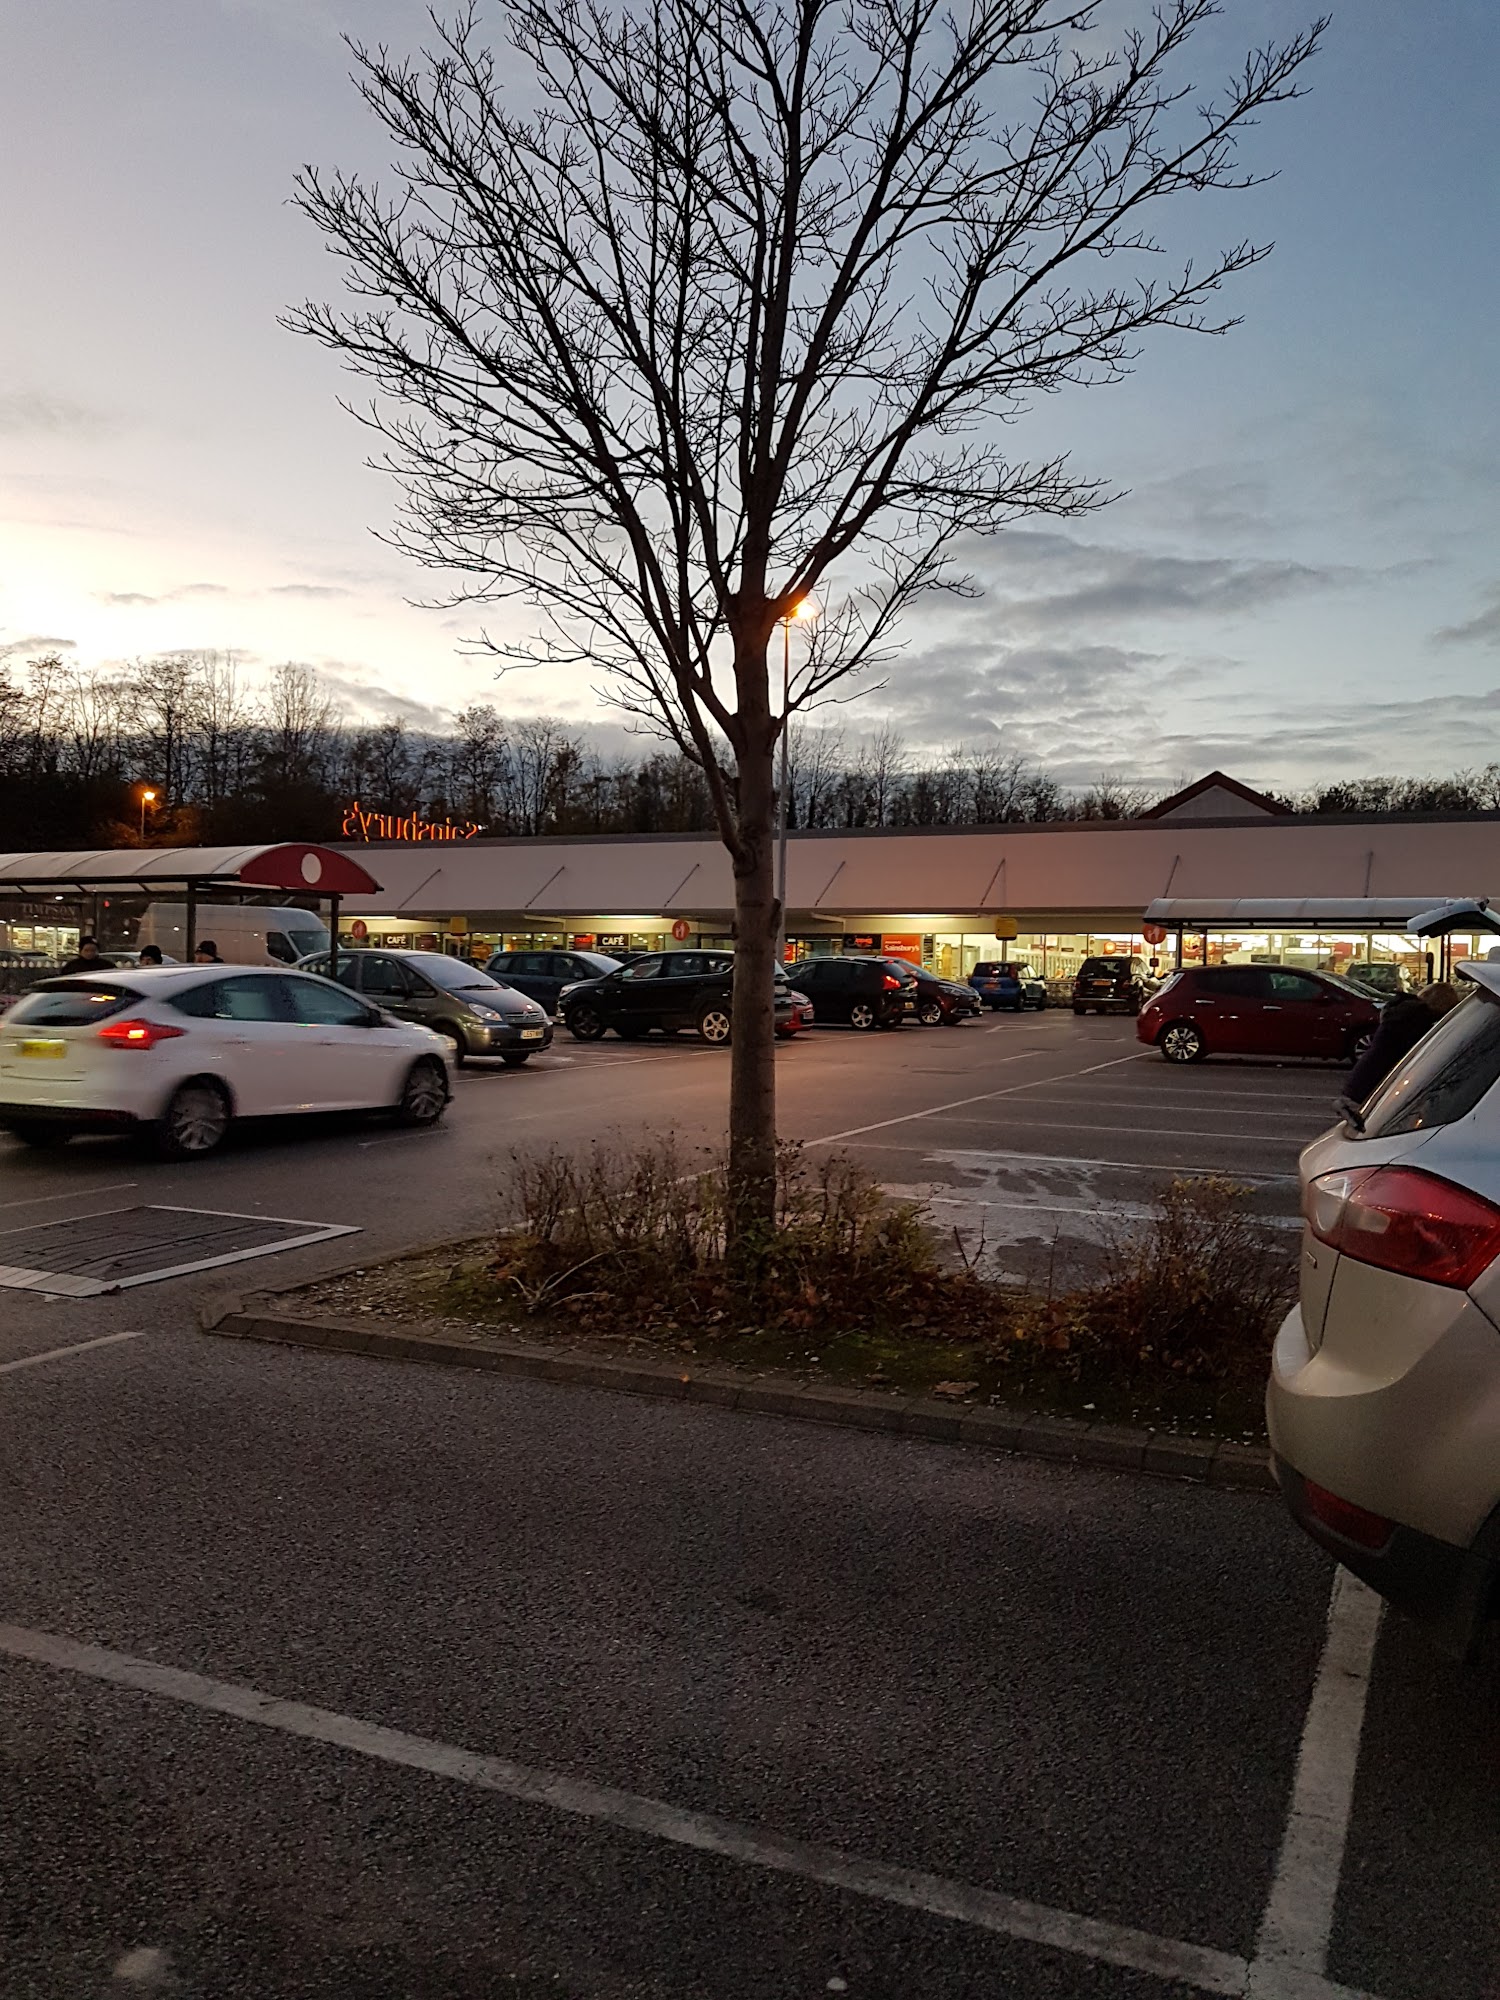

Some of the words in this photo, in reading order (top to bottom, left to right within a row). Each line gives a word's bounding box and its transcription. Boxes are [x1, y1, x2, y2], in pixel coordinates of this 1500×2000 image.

[387, 935, 406, 944] CAFÉ
[602, 935, 624, 946] CAFÉ
[884, 944, 920, 952] Sainsbury's
